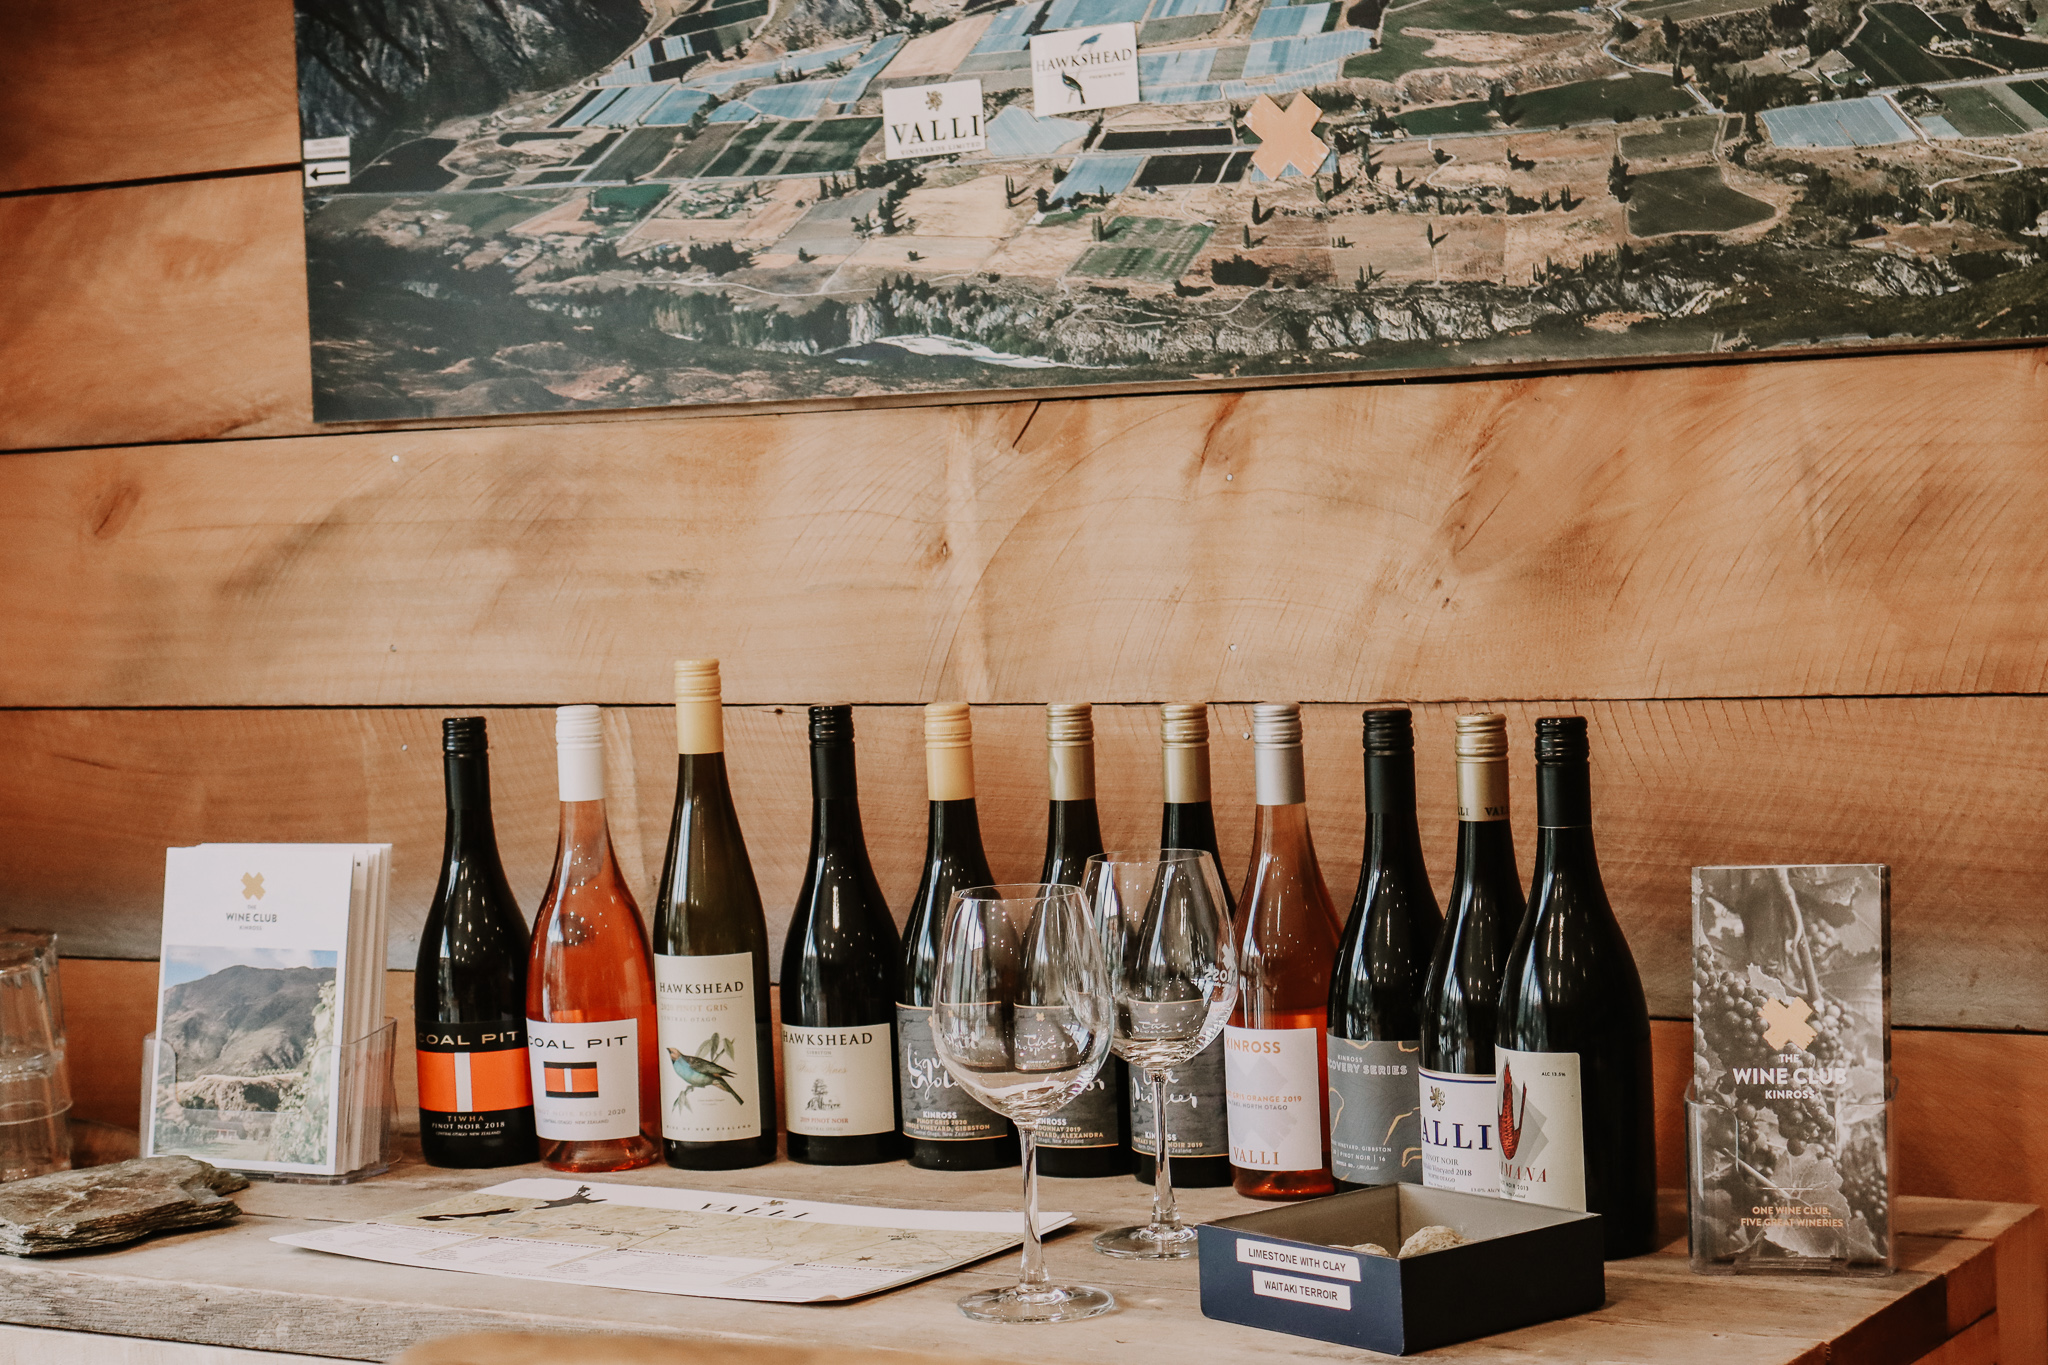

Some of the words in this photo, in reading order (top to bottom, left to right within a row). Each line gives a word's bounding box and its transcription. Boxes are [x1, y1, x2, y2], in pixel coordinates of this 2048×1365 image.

[1036, 48, 1132, 72] HAWKSHEAD
[891, 115, 979, 145] VALLI
[226, 912, 250, 922] WINE
[253, 913, 277, 923] CLUB
[659, 981, 744, 994] HAWKSHEAD
[705, 1003, 728, 1012] GRIS
[418, 1033, 471, 1046] COAL
[481, 1031, 519, 1045] PIT
[528, 1035, 575, 1049] COAL
[587, 1035, 628, 1048] PIT
[783, 1031, 873, 1046] HAWKSHEAD
[1226, 1037, 1282, 1054] KINROSS
[1337, 1054, 1363, 1063] KINROSS
[1779, 1053, 1800, 1063] THE
[1328, 1059, 1360, 1074] COVERY
[1362, 1064, 1408, 1076] SERIES
[1732, 1067, 1788, 1085] WINE
[1793, 1067, 1847, 1085] CLUB
[1133, 1077, 1198, 1108] Pioeer
[1765, 1090, 1815, 1099] KINROSS
[1247, 1094, 1280, 1103] ORANGE
[1283, 1095, 1302, 1103] 2019
[1242, 1102, 1263, 1110] NORTH
[608, 1108, 626, 1116] 2020
[922, 1111, 957, 1120] KINROSS
[431, 1122, 454, 1130] PINOT
[484, 1121, 505, 1129] 2018
[1145, 1132, 1178, 1142] KINSS
[1422, 1116, 1493, 1151] ALLI
[1361, 1145, 1392, 1153] GIBBSTON
[1233, 1147, 1279, 1165] VALLI
[1440, 1157, 1459, 1166] NOIR
[1456, 1168, 1472, 1177] 2018
[1752, 1206, 1774, 1215] ONE
[1775, 1206, 1801, 1215] WINE
[1740, 1217, 1762, 1227] FIVE
[1763, 1217, 1795, 1227] GREAT
[1796, 1217, 1844, 1228] WINERIES
[1248, 1247, 1298, 1265] LIMESTONE
[1299, 1256, 1321, 1268] WITH
[1322, 1260, 1346, 1272] CLAY
[1264, 1280, 1298, 1294] WAITAKI
[1299, 1285, 1339, 1301] TERROIR
